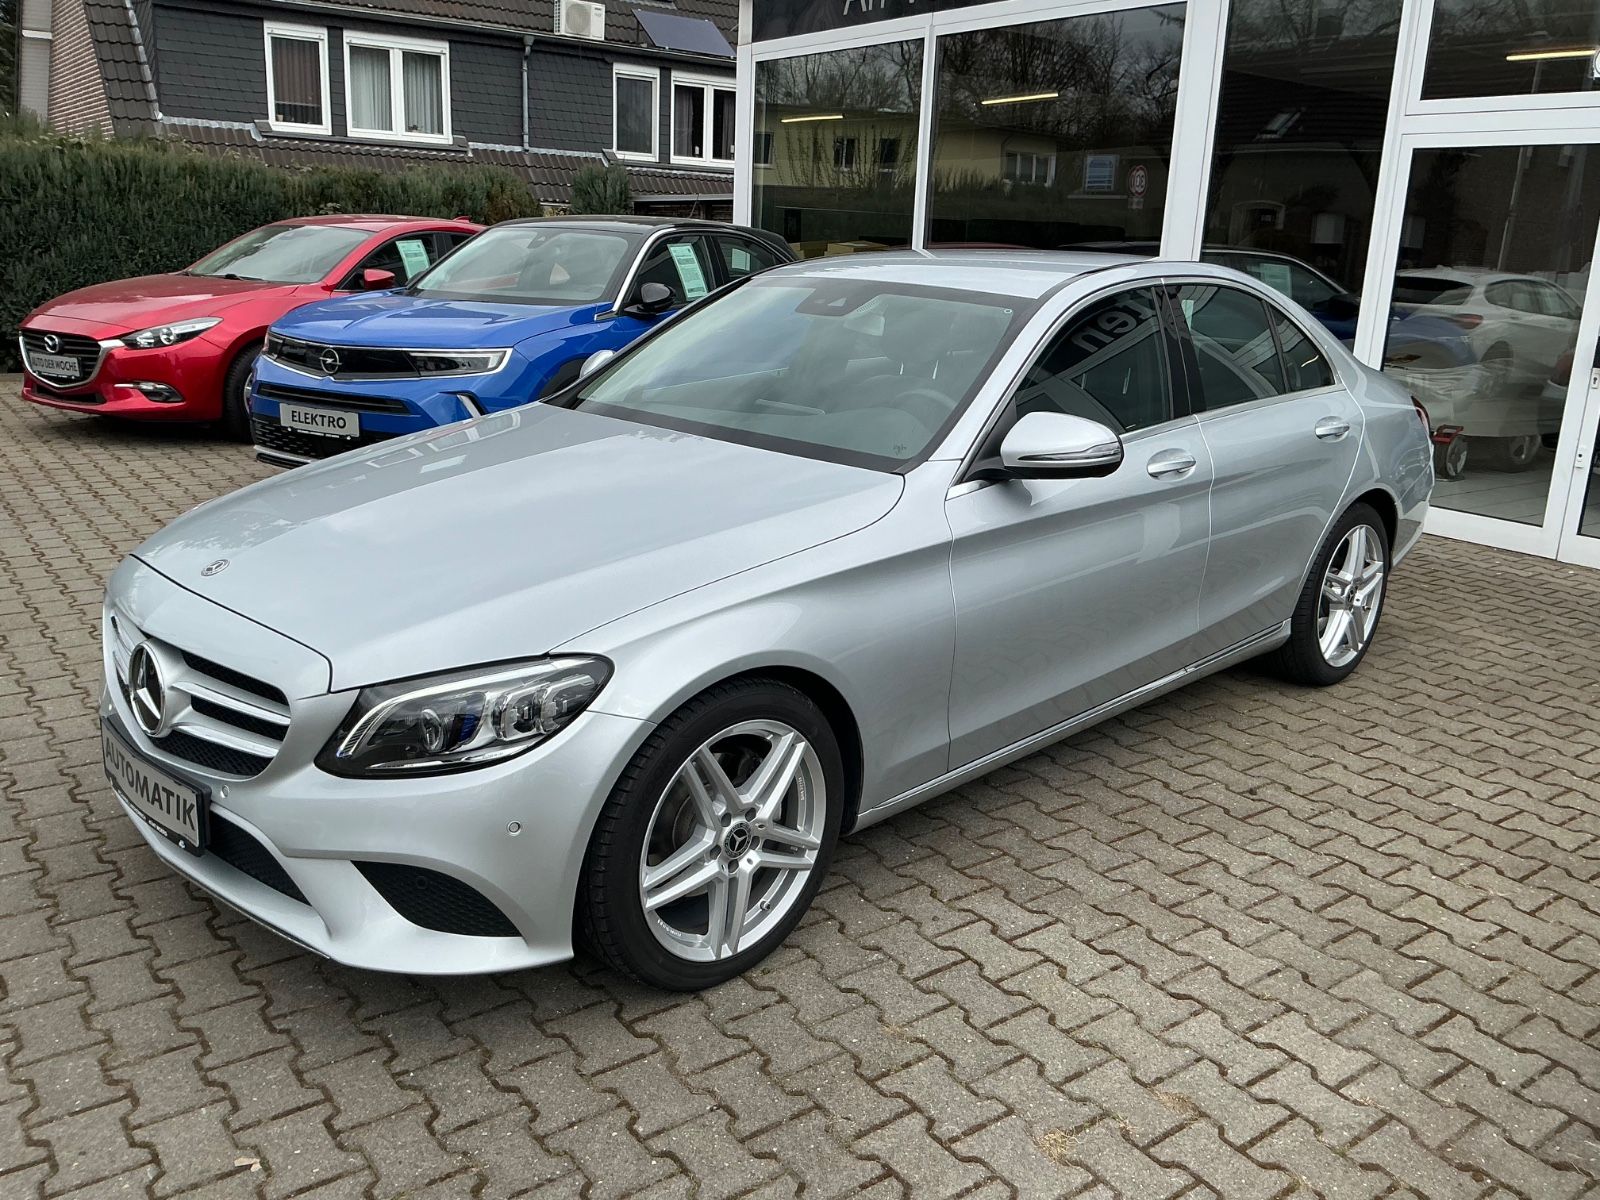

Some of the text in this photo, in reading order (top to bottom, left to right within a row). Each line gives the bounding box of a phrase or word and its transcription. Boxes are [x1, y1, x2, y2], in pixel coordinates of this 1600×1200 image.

[55, 360, 78, 372] WOCHE
[291, 410, 347, 429] ELEKTRO
[105, 738, 196, 832] AUTOMATIK
